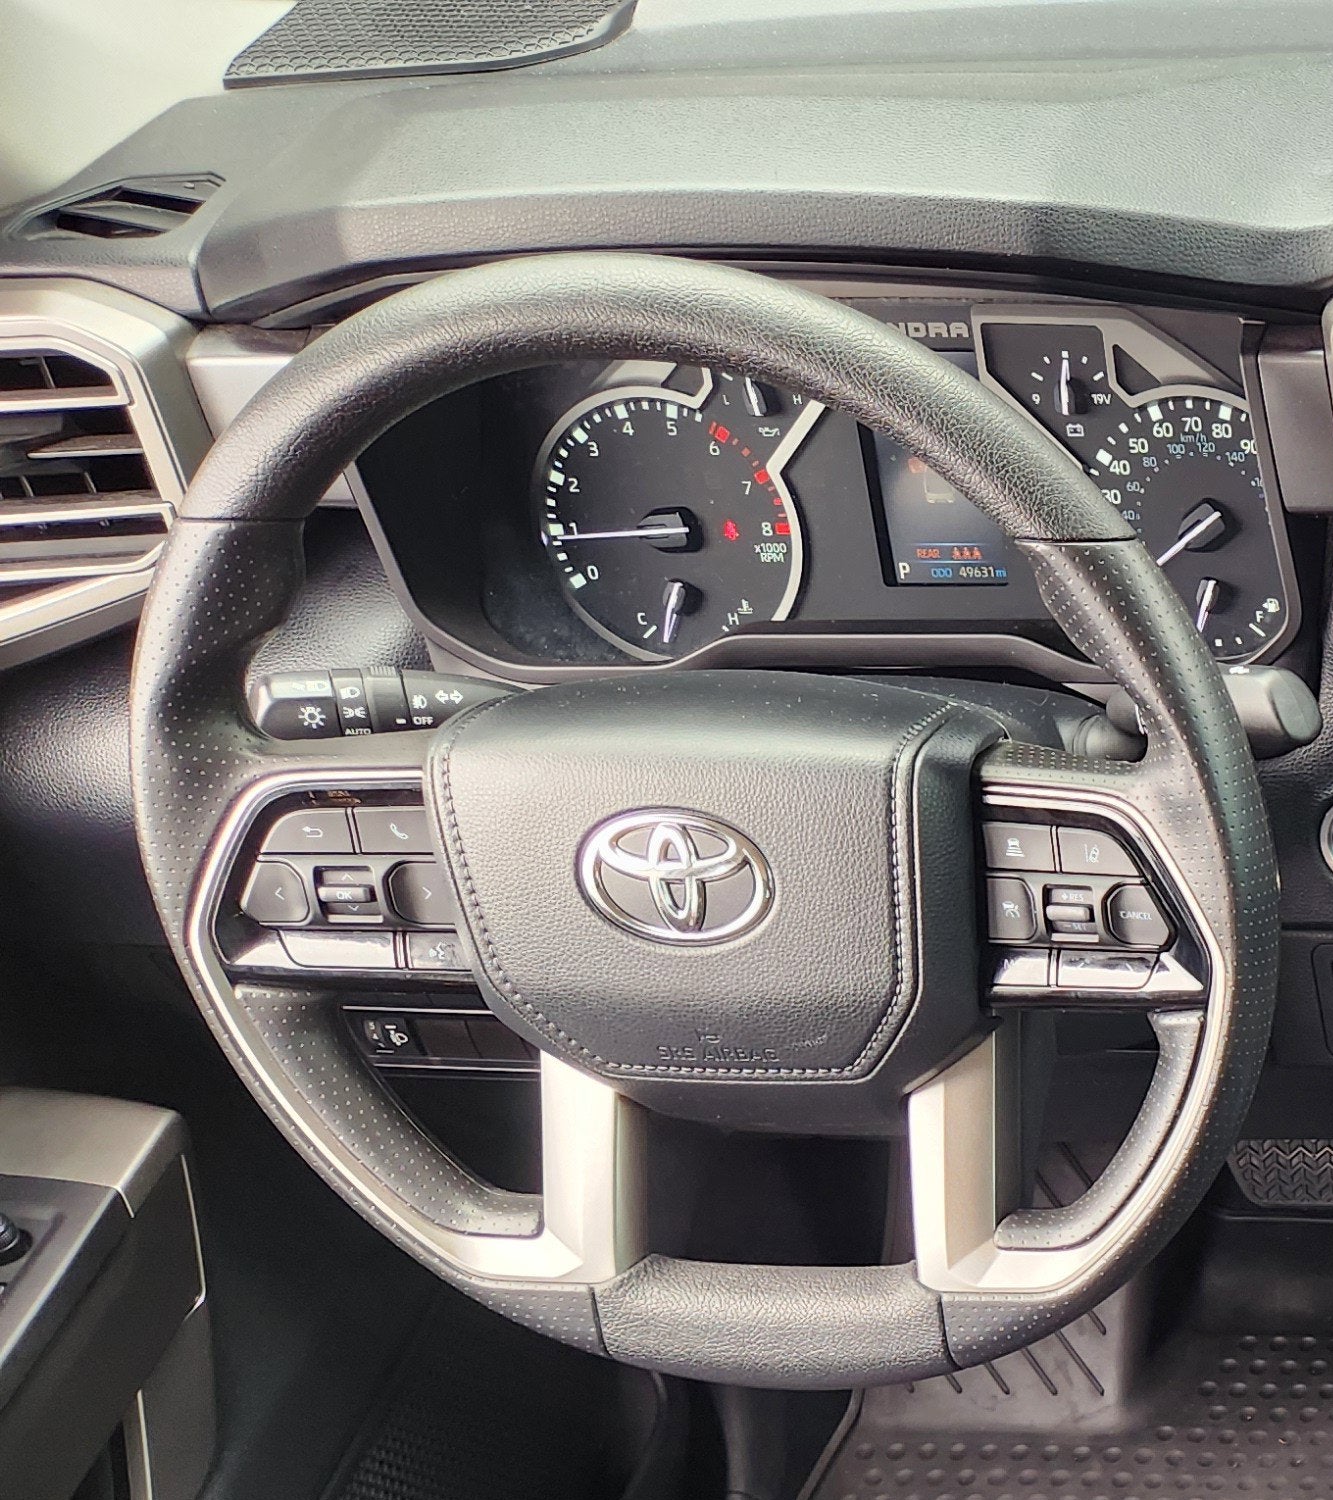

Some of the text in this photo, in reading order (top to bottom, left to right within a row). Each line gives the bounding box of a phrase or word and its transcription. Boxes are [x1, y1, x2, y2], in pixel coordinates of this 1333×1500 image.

[792, 394, 803, 406] H
[1031, 393, 1041, 405] 9
[1090, 393, 1112, 405] 19V
[622, 421, 635, 437] 4
[666, 421, 678, 437] 5
[1152, 422, 1174, 438] 60
[1181, 416, 1203, 433] 70
[1211, 423, 1233, 439] 80
[1180, 433, 1207, 444] km/h
[588, 441, 599, 457] 3
[709, 441, 721, 456] 6
[1129, 438, 1149, 454] 50
[1167, 443, 1186, 455] 100
[1197, 442, 1216, 453] 120
[1142, 456, 1157, 468] 80
[1225, 451, 1246, 463] 140
[1109, 460, 1131, 476] 40
[568, 477, 580, 493] 2
[741, 481, 752, 496] 7
[1126, 481, 1141, 492] 60
[1101, 489, 1122, 505] 30
[568, 521, 579, 536] 1
[761, 522, 774, 537] 8
[754, 542, 787, 553] x1000
[916, 548, 941, 559] REAR
[760, 552, 785, 563] RPM
[586, 564, 599, 580] 0
[898, 562, 911, 580] P
[931, 566, 995, 578] ODO 49631
[637, 612, 648, 625] C
[728, 612, 740, 626] H
[1255, 610, 1264, 622] F
[413, 716, 434, 725] OFF
[345, 728, 372, 736] AUTO
[336, 890, 353, 900] OK
[1119, 910, 1153, 921] CANCEL
[704, 1047, 780, 1062] AIRBAG
